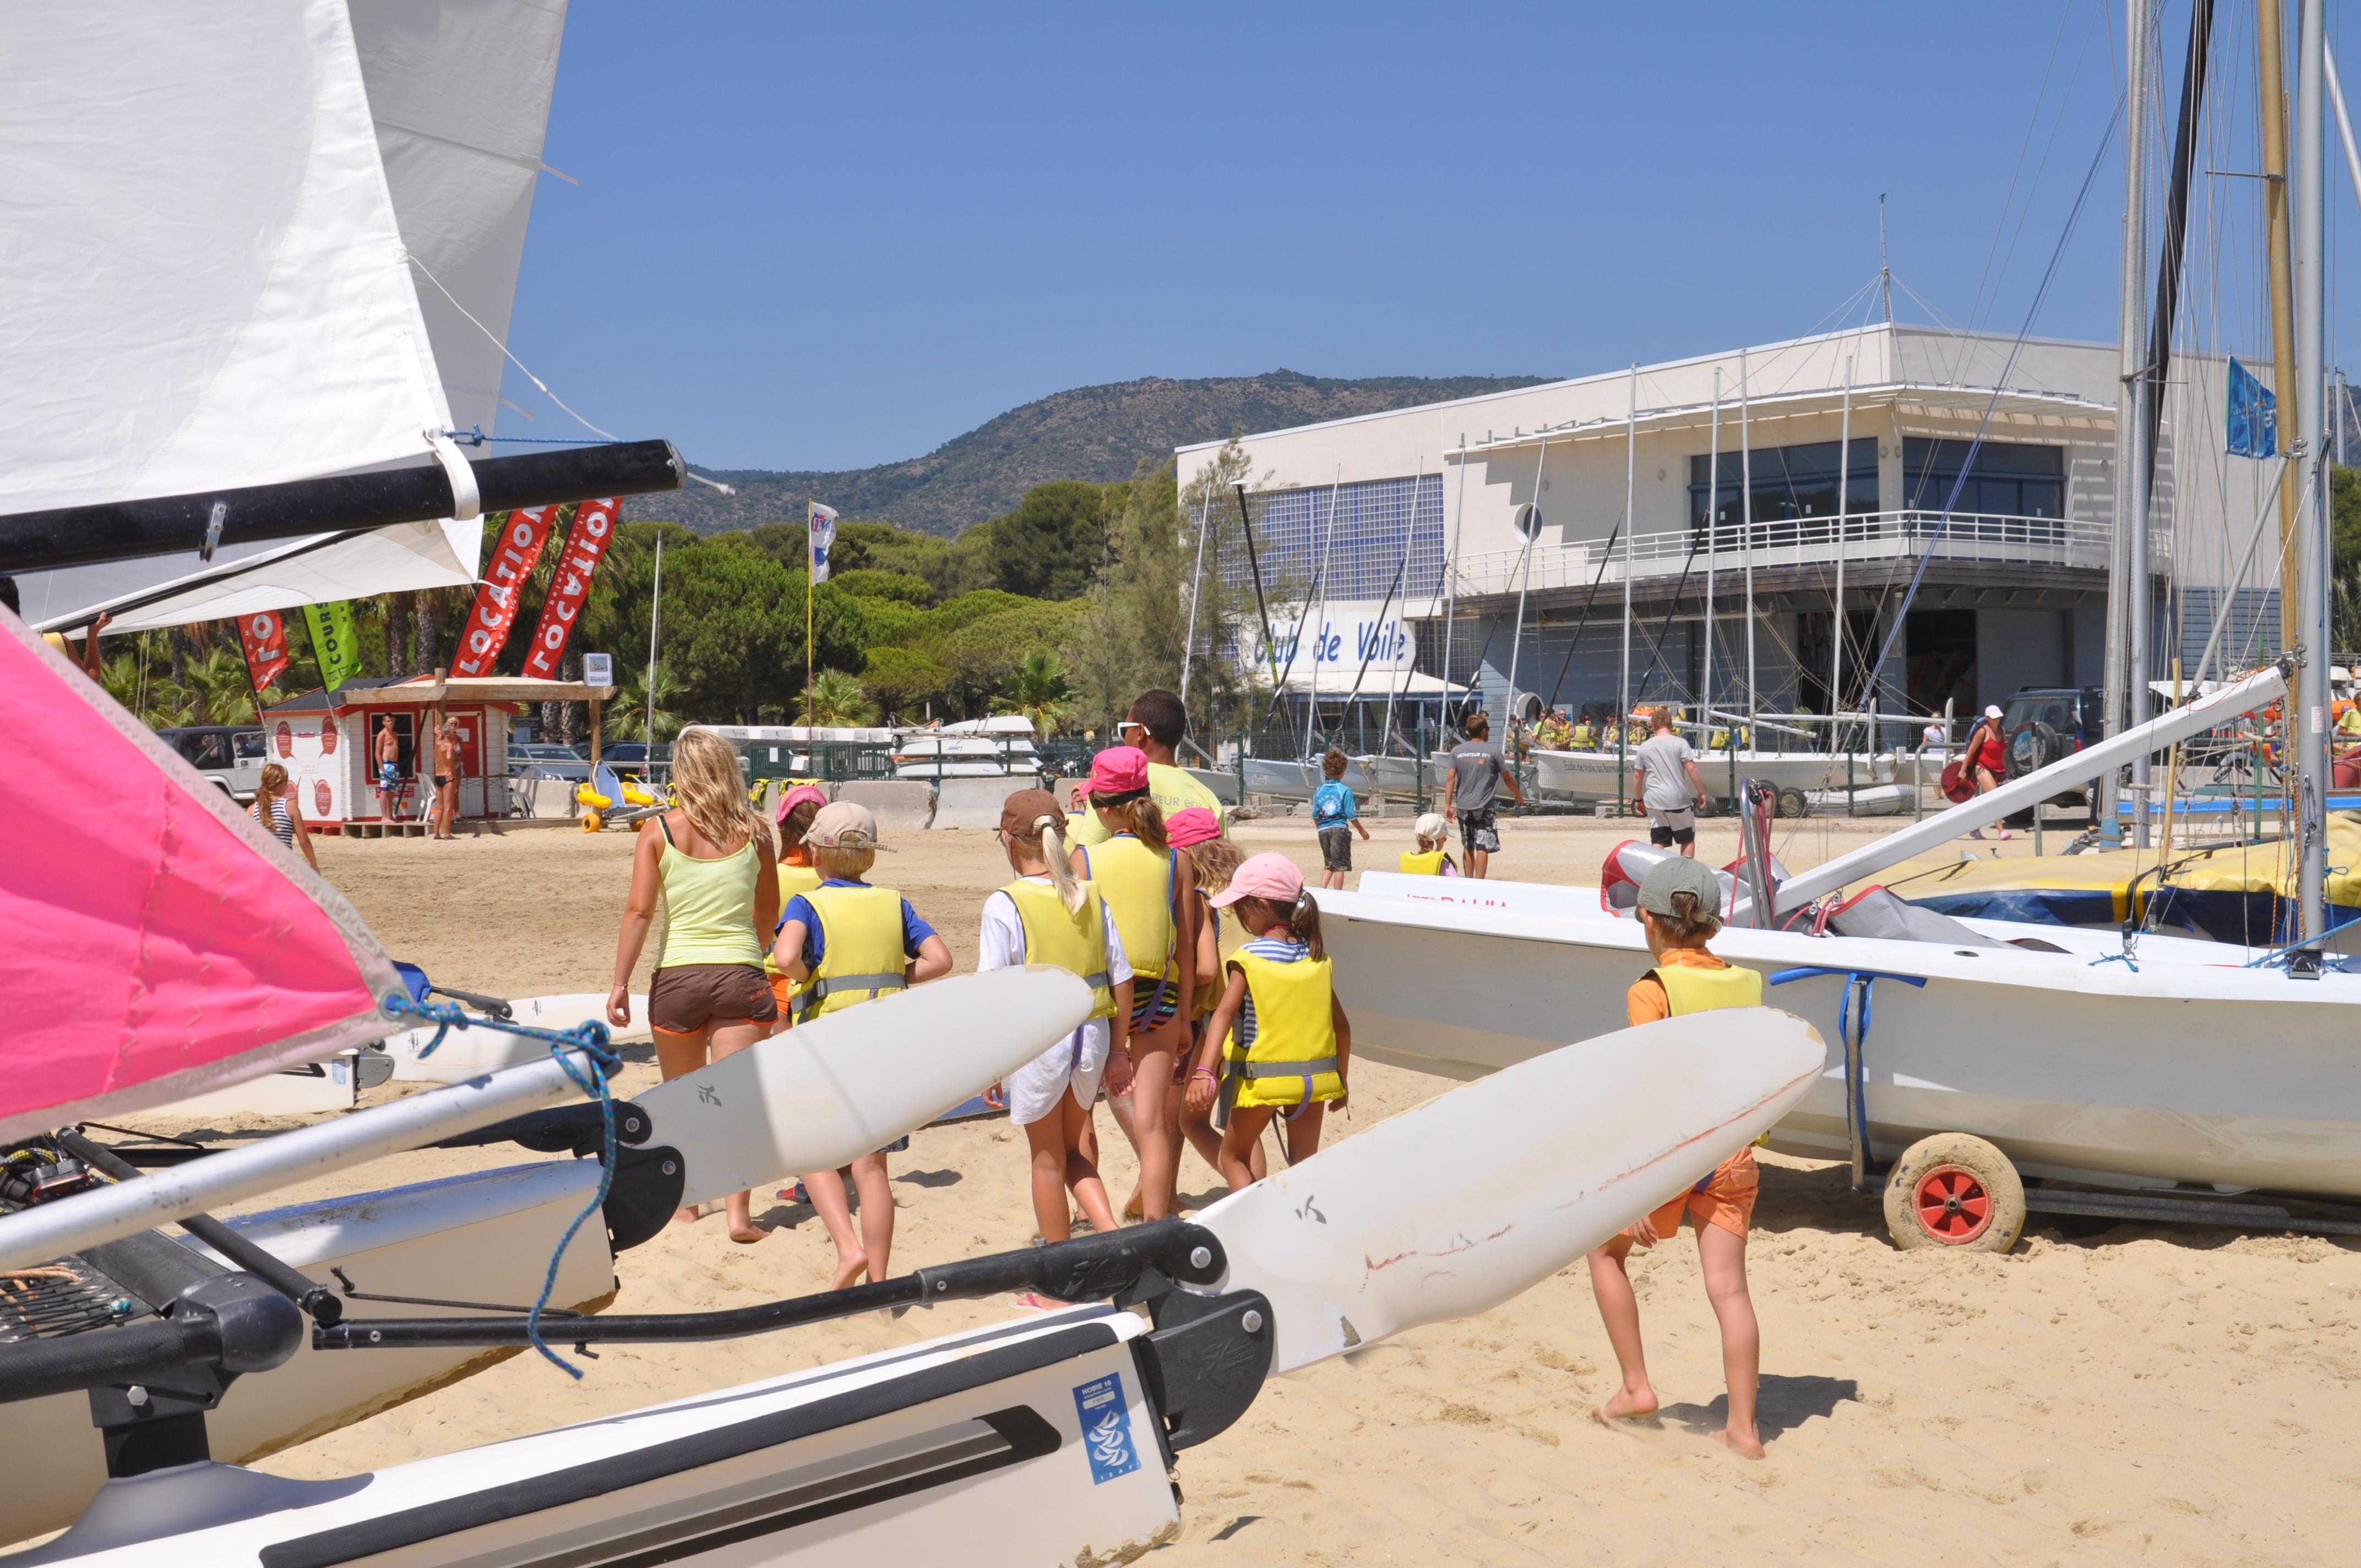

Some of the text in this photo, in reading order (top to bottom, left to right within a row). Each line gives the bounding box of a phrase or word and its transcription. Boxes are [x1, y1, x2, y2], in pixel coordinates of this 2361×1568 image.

[1255, 623, 1297, 664] Club
[1313, 622, 1340, 661] de
[1358, 620, 1405, 661] Voile
[1082, 1383, 1103, 1395] HOBIE
